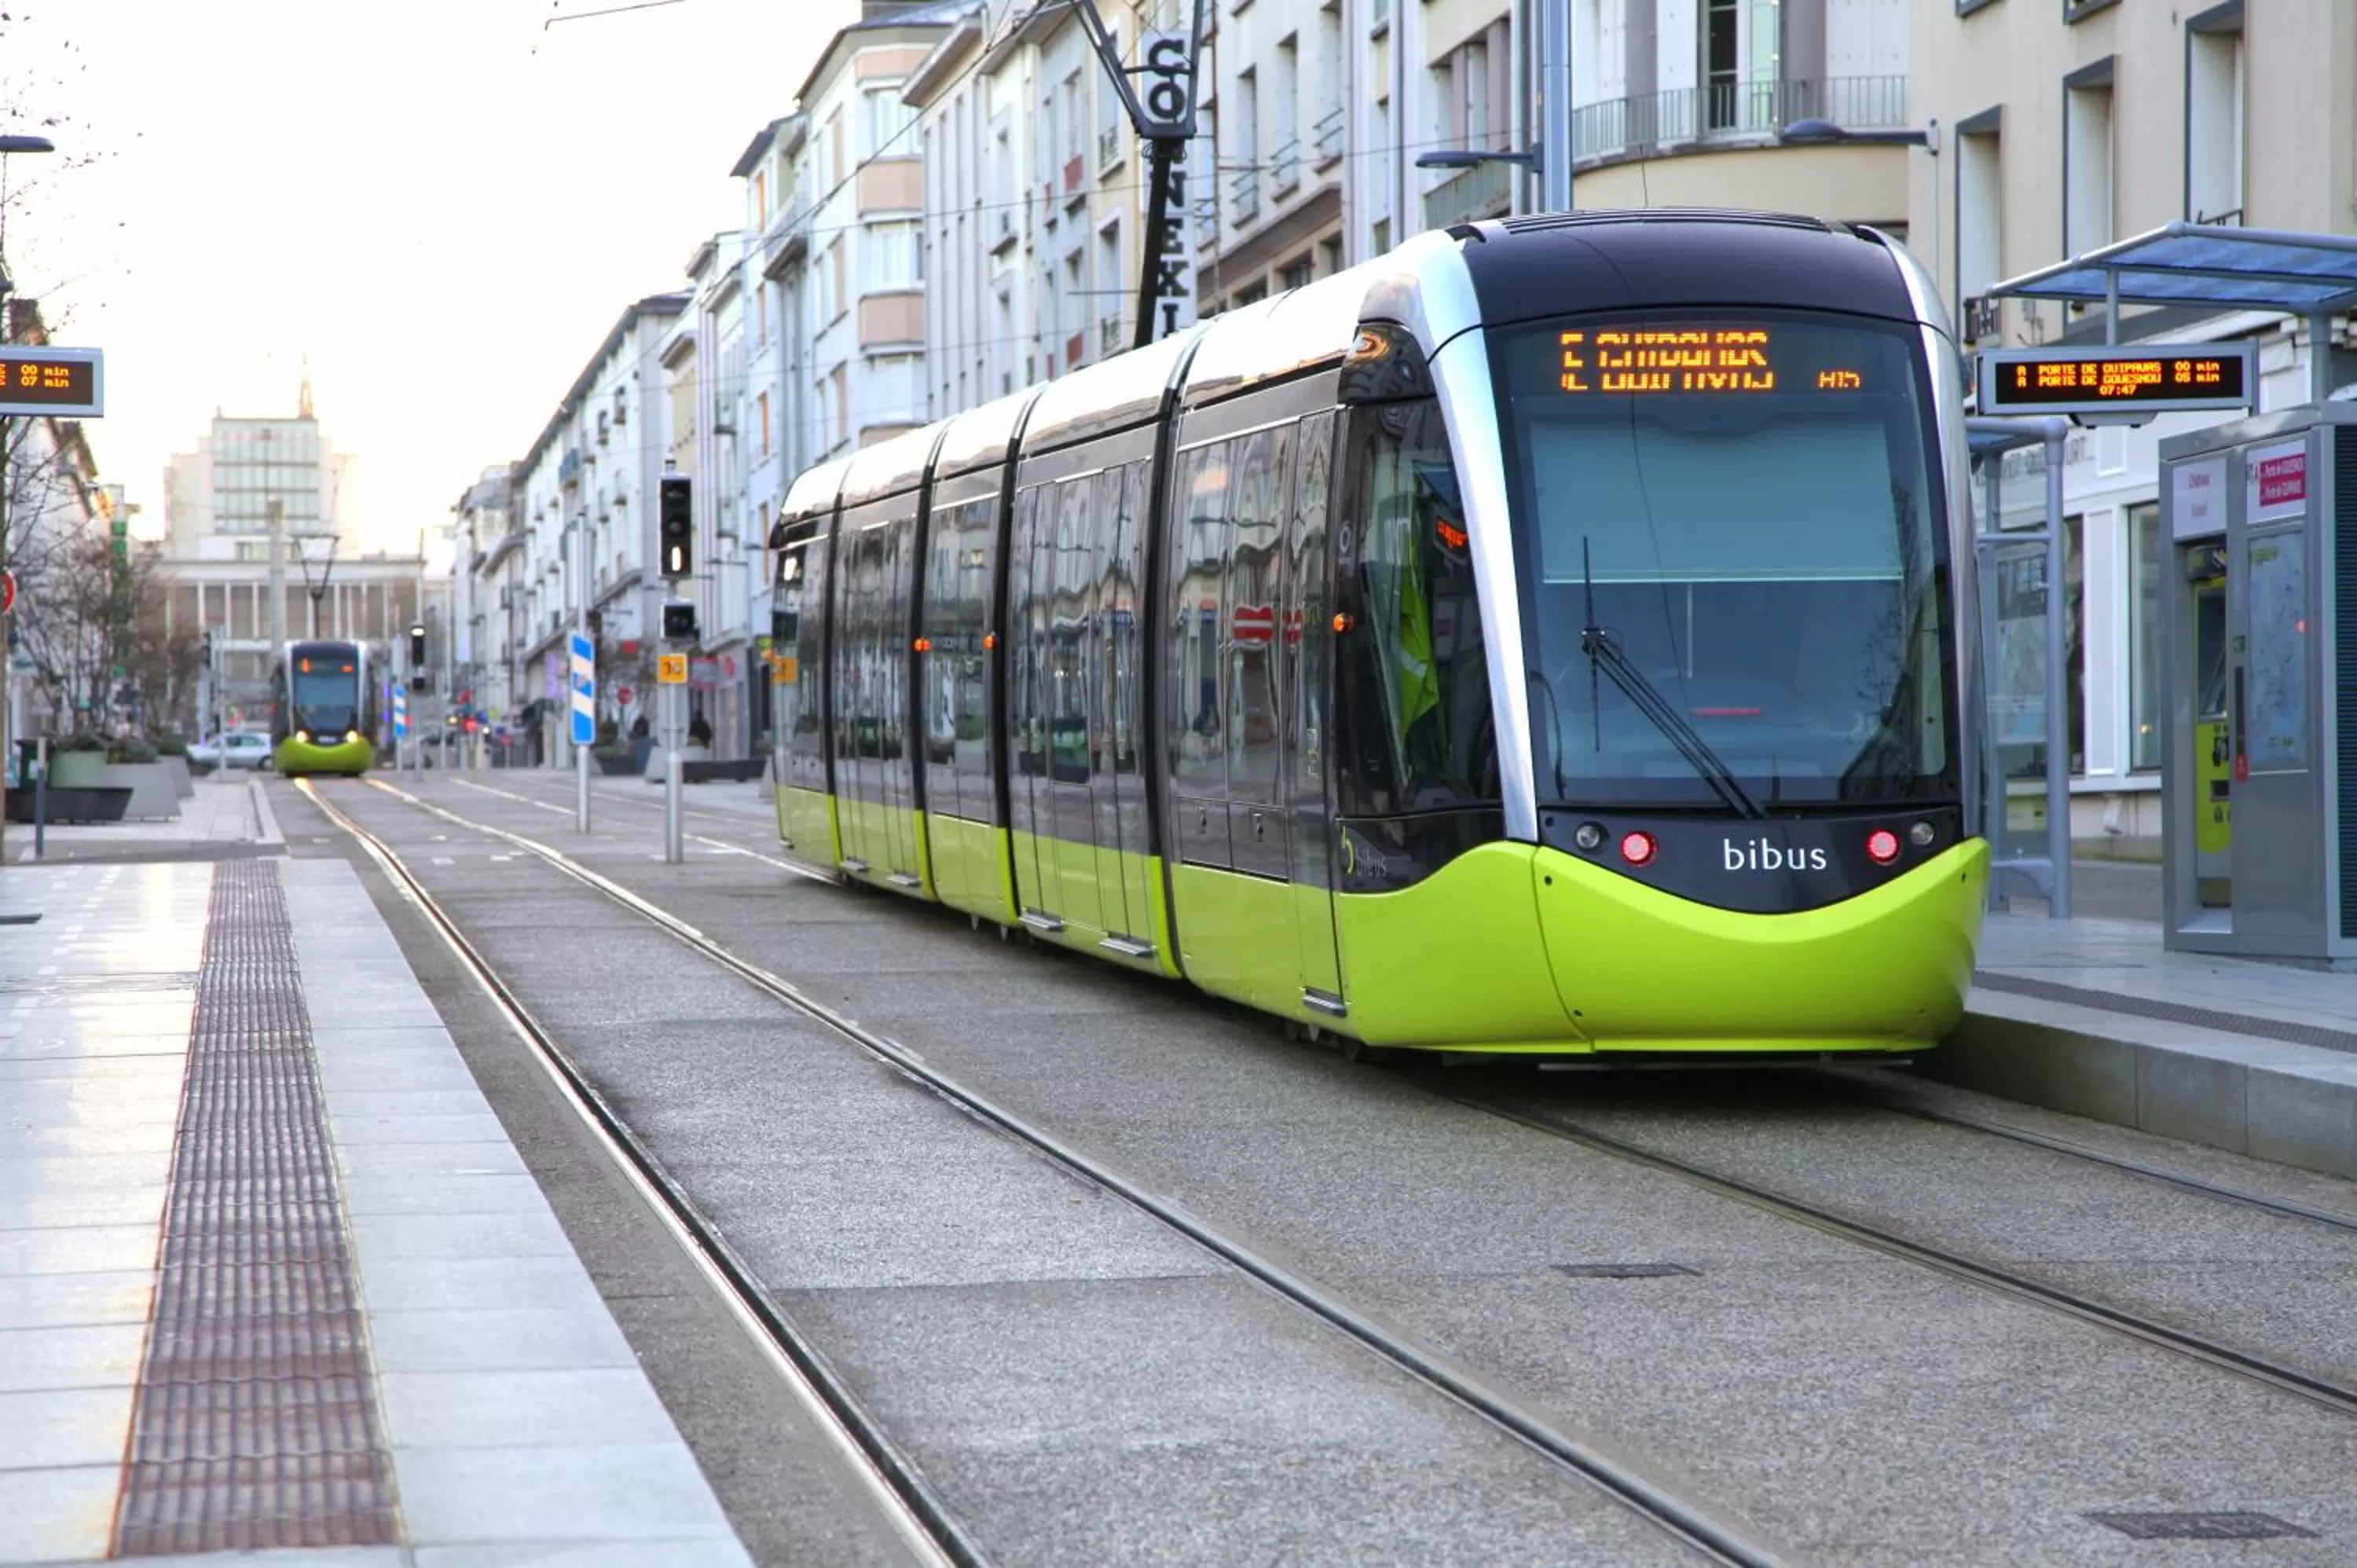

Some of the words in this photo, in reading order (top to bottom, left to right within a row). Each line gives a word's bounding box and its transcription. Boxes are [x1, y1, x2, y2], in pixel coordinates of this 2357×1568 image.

[2038, 364, 2076, 376] PORTE
[2080, 363, 2097, 374] DE
[2038, 375, 2077, 387] PORTE
[2080, 374, 2097, 386] DE
[1724, 837, 1827, 870] bibus
